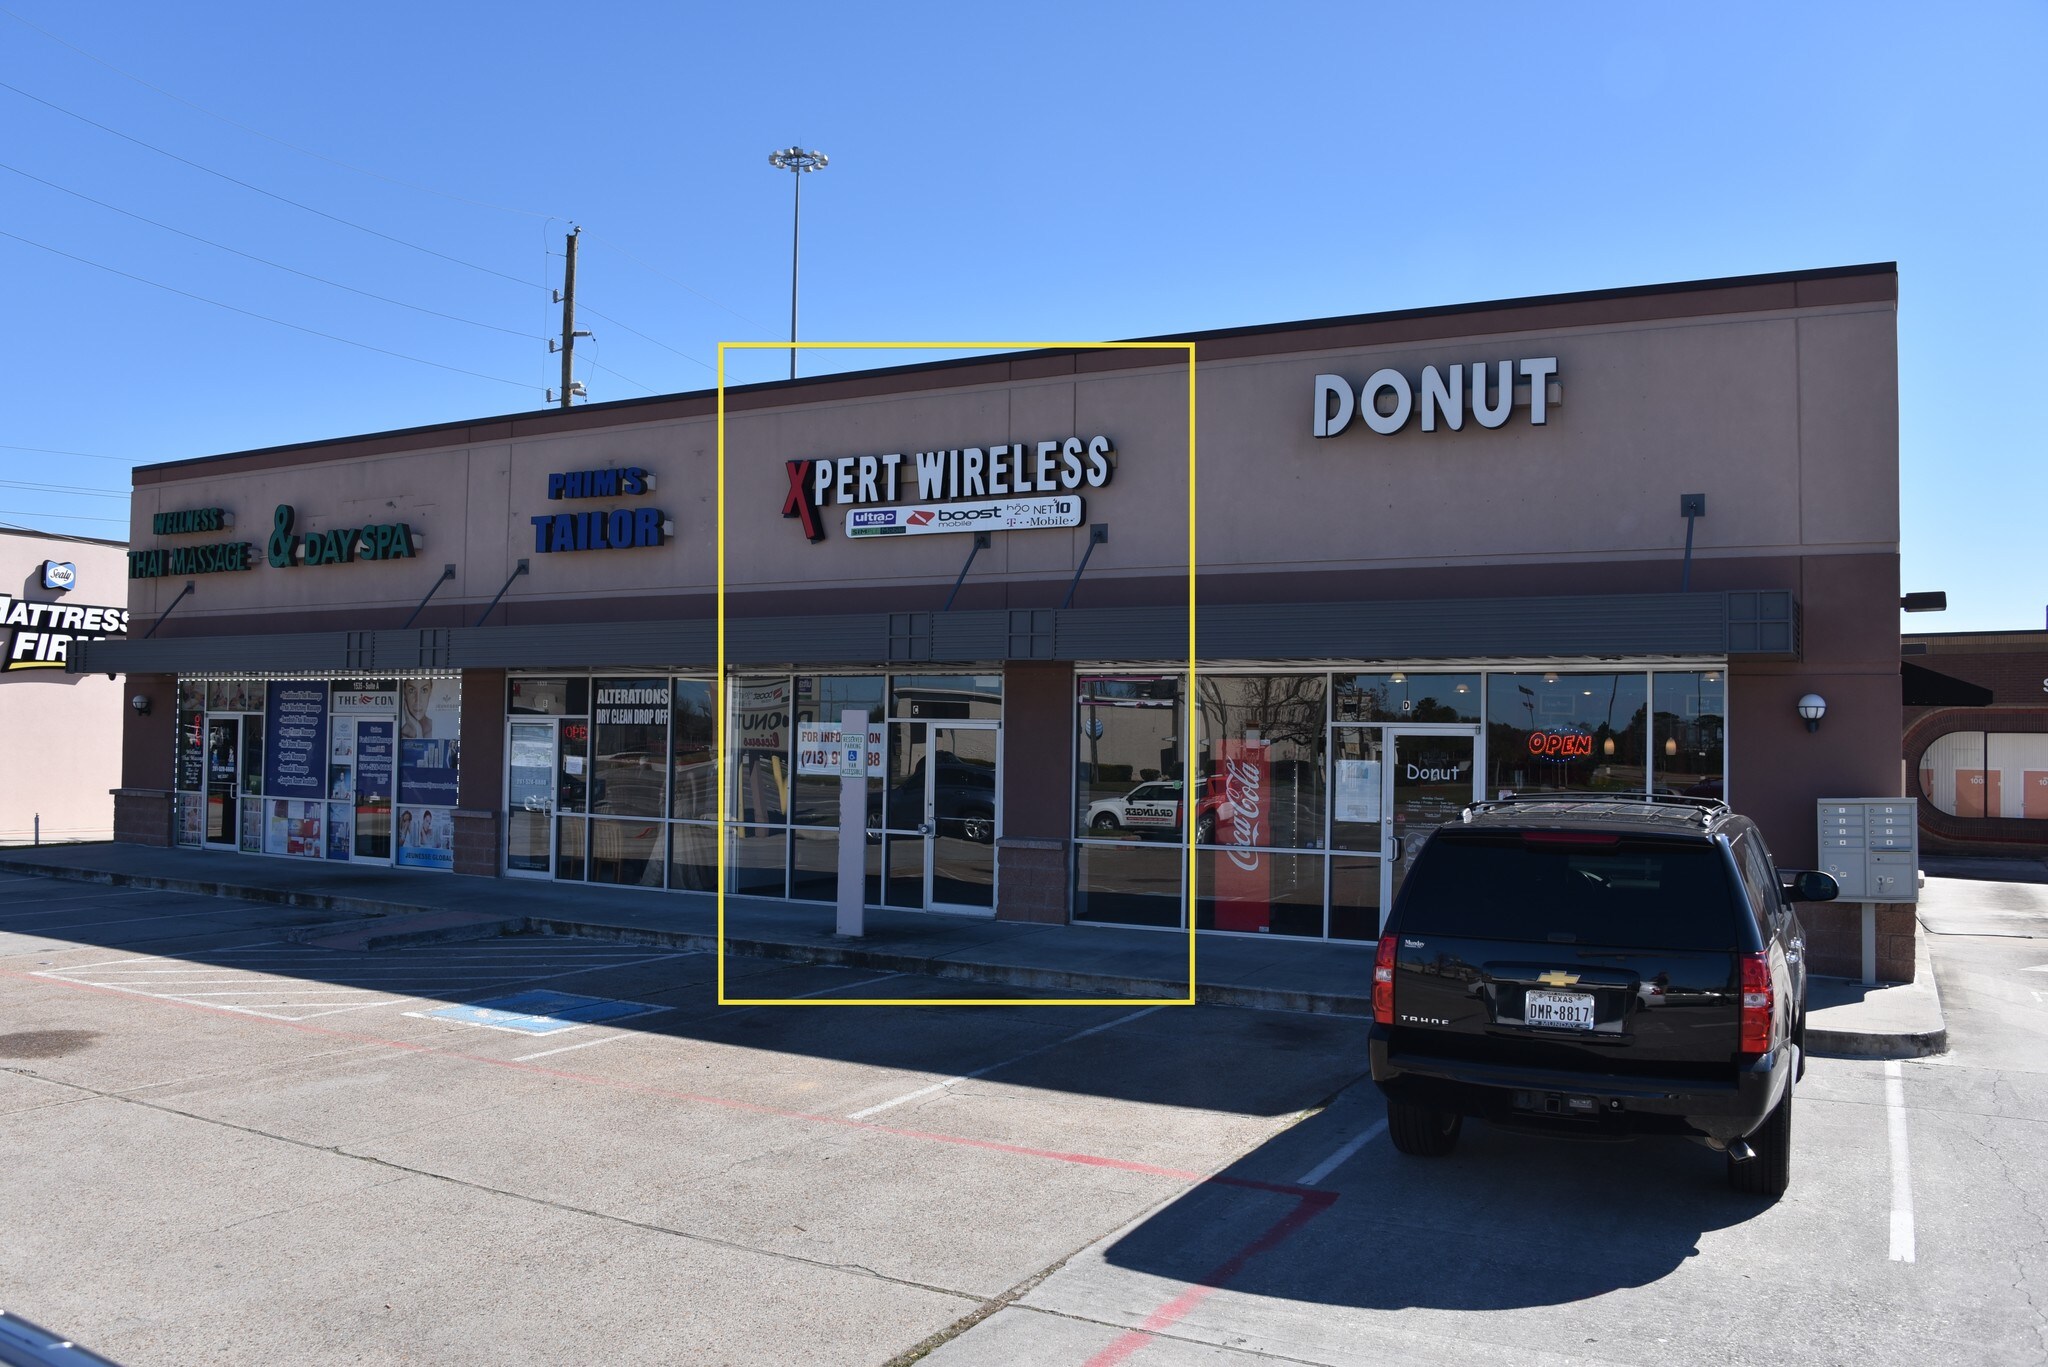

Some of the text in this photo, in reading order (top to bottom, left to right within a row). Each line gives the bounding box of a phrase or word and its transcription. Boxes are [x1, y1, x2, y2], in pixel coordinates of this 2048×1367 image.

[1313, 356, 1558, 439] DONUT
[547, 466, 646, 500] PHIM'S
[782, 434, 1115, 544] XPERT WIRELESS
[152, 507, 224, 535] WELLNESS
[854, 512, 893, 522] ultra
[938, 506, 1003, 522] boost
[530, 507, 665, 554] TAILOR
[938, 519, 972, 528] mobile
[267, 504, 416, 569] & DAY SPA
[127, 541, 252, 580] THAI MASSAGE
[50, 569, 72, 583] Sealy
[12, 632, 106, 662] FIR
[338, 695, 358, 705] THE
[596, 688, 668, 705] ALTERATIONS
[596, 708, 668, 724] DRY CLEAN DROP OFF
[564, 726, 588, 739] OPE
[801, 732, 819, 743] FOR
[1528, 731, 1592, 756] OPEN
[801, 750, 828, 768] (713)
[1407, 763, 1460, 781] Donut
[1404, 939, 1425, 947] Munday
[1547, 995, 1574, 1004] TEXAS
[1401, 1014, 1449, 1025] TAHOE
